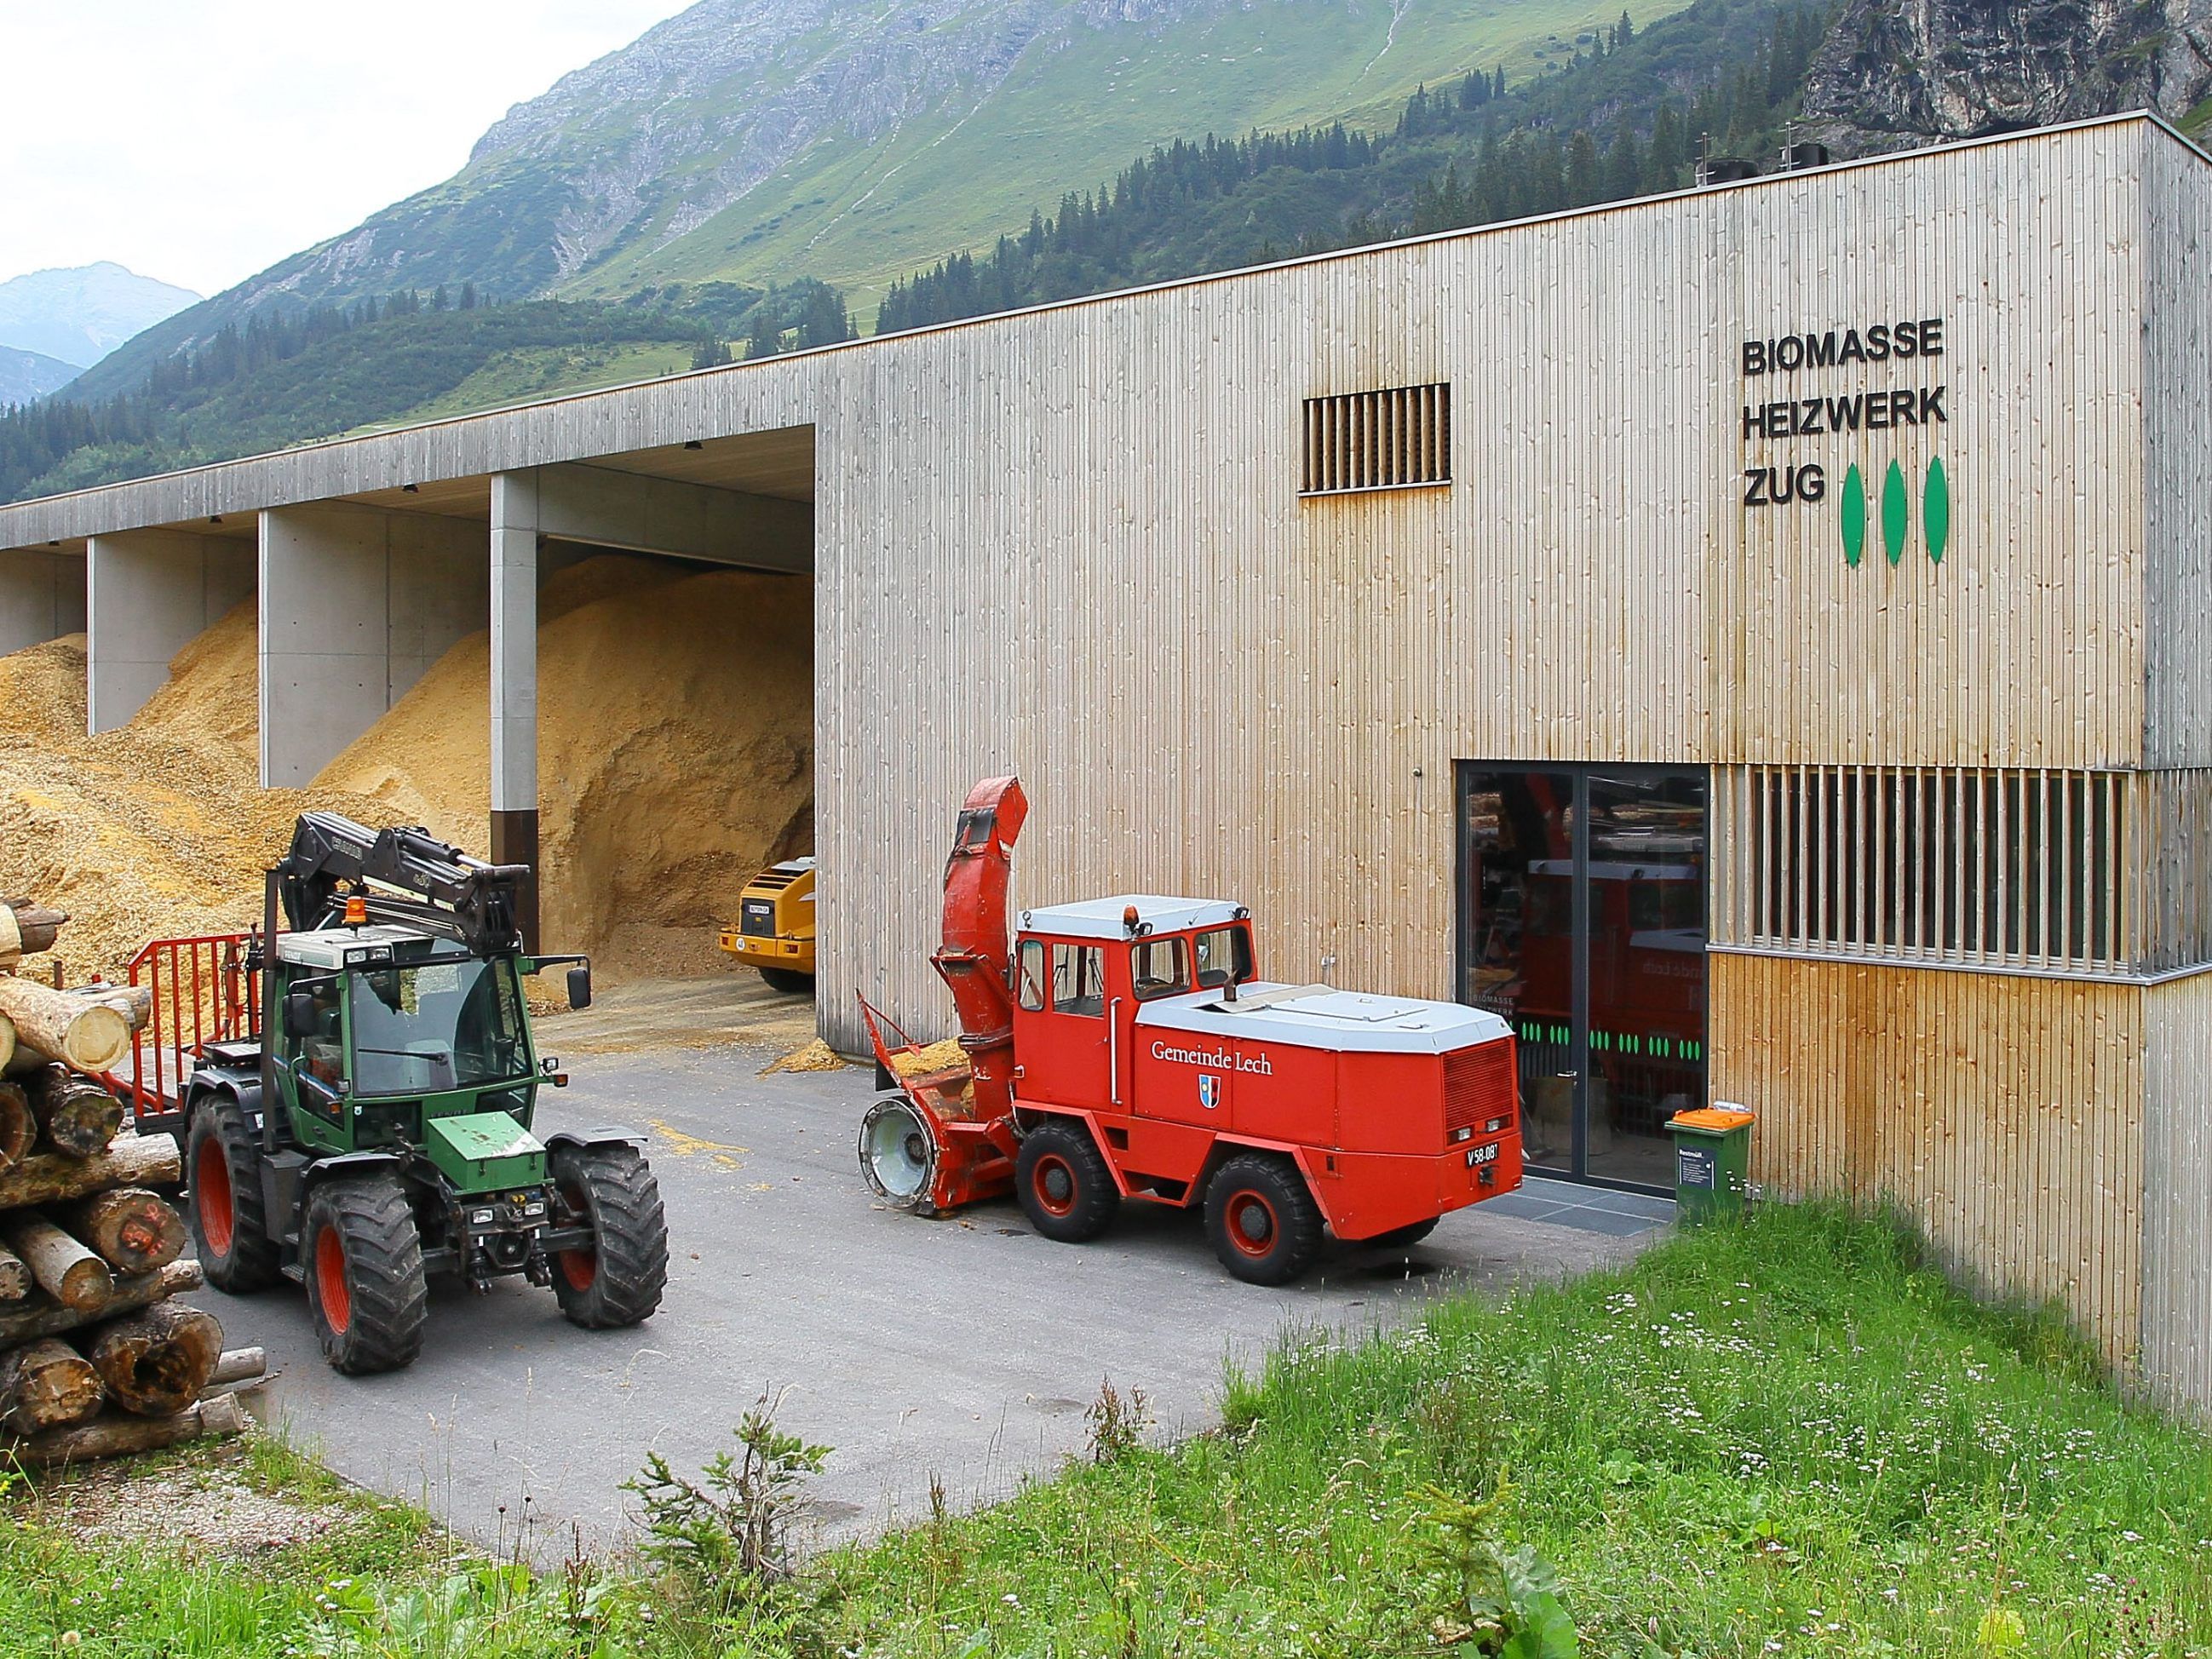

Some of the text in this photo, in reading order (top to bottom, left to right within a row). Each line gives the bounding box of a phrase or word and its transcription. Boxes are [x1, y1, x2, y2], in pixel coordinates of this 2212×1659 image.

[1743, 319, 1943, 376] BIOMASSE
[1744, 386, 1947, 439] HEIZWERK
[1744, 463, 1824, 506] ZUG
[1151, 1040, 1273, 1076] Gemeinde Lech
